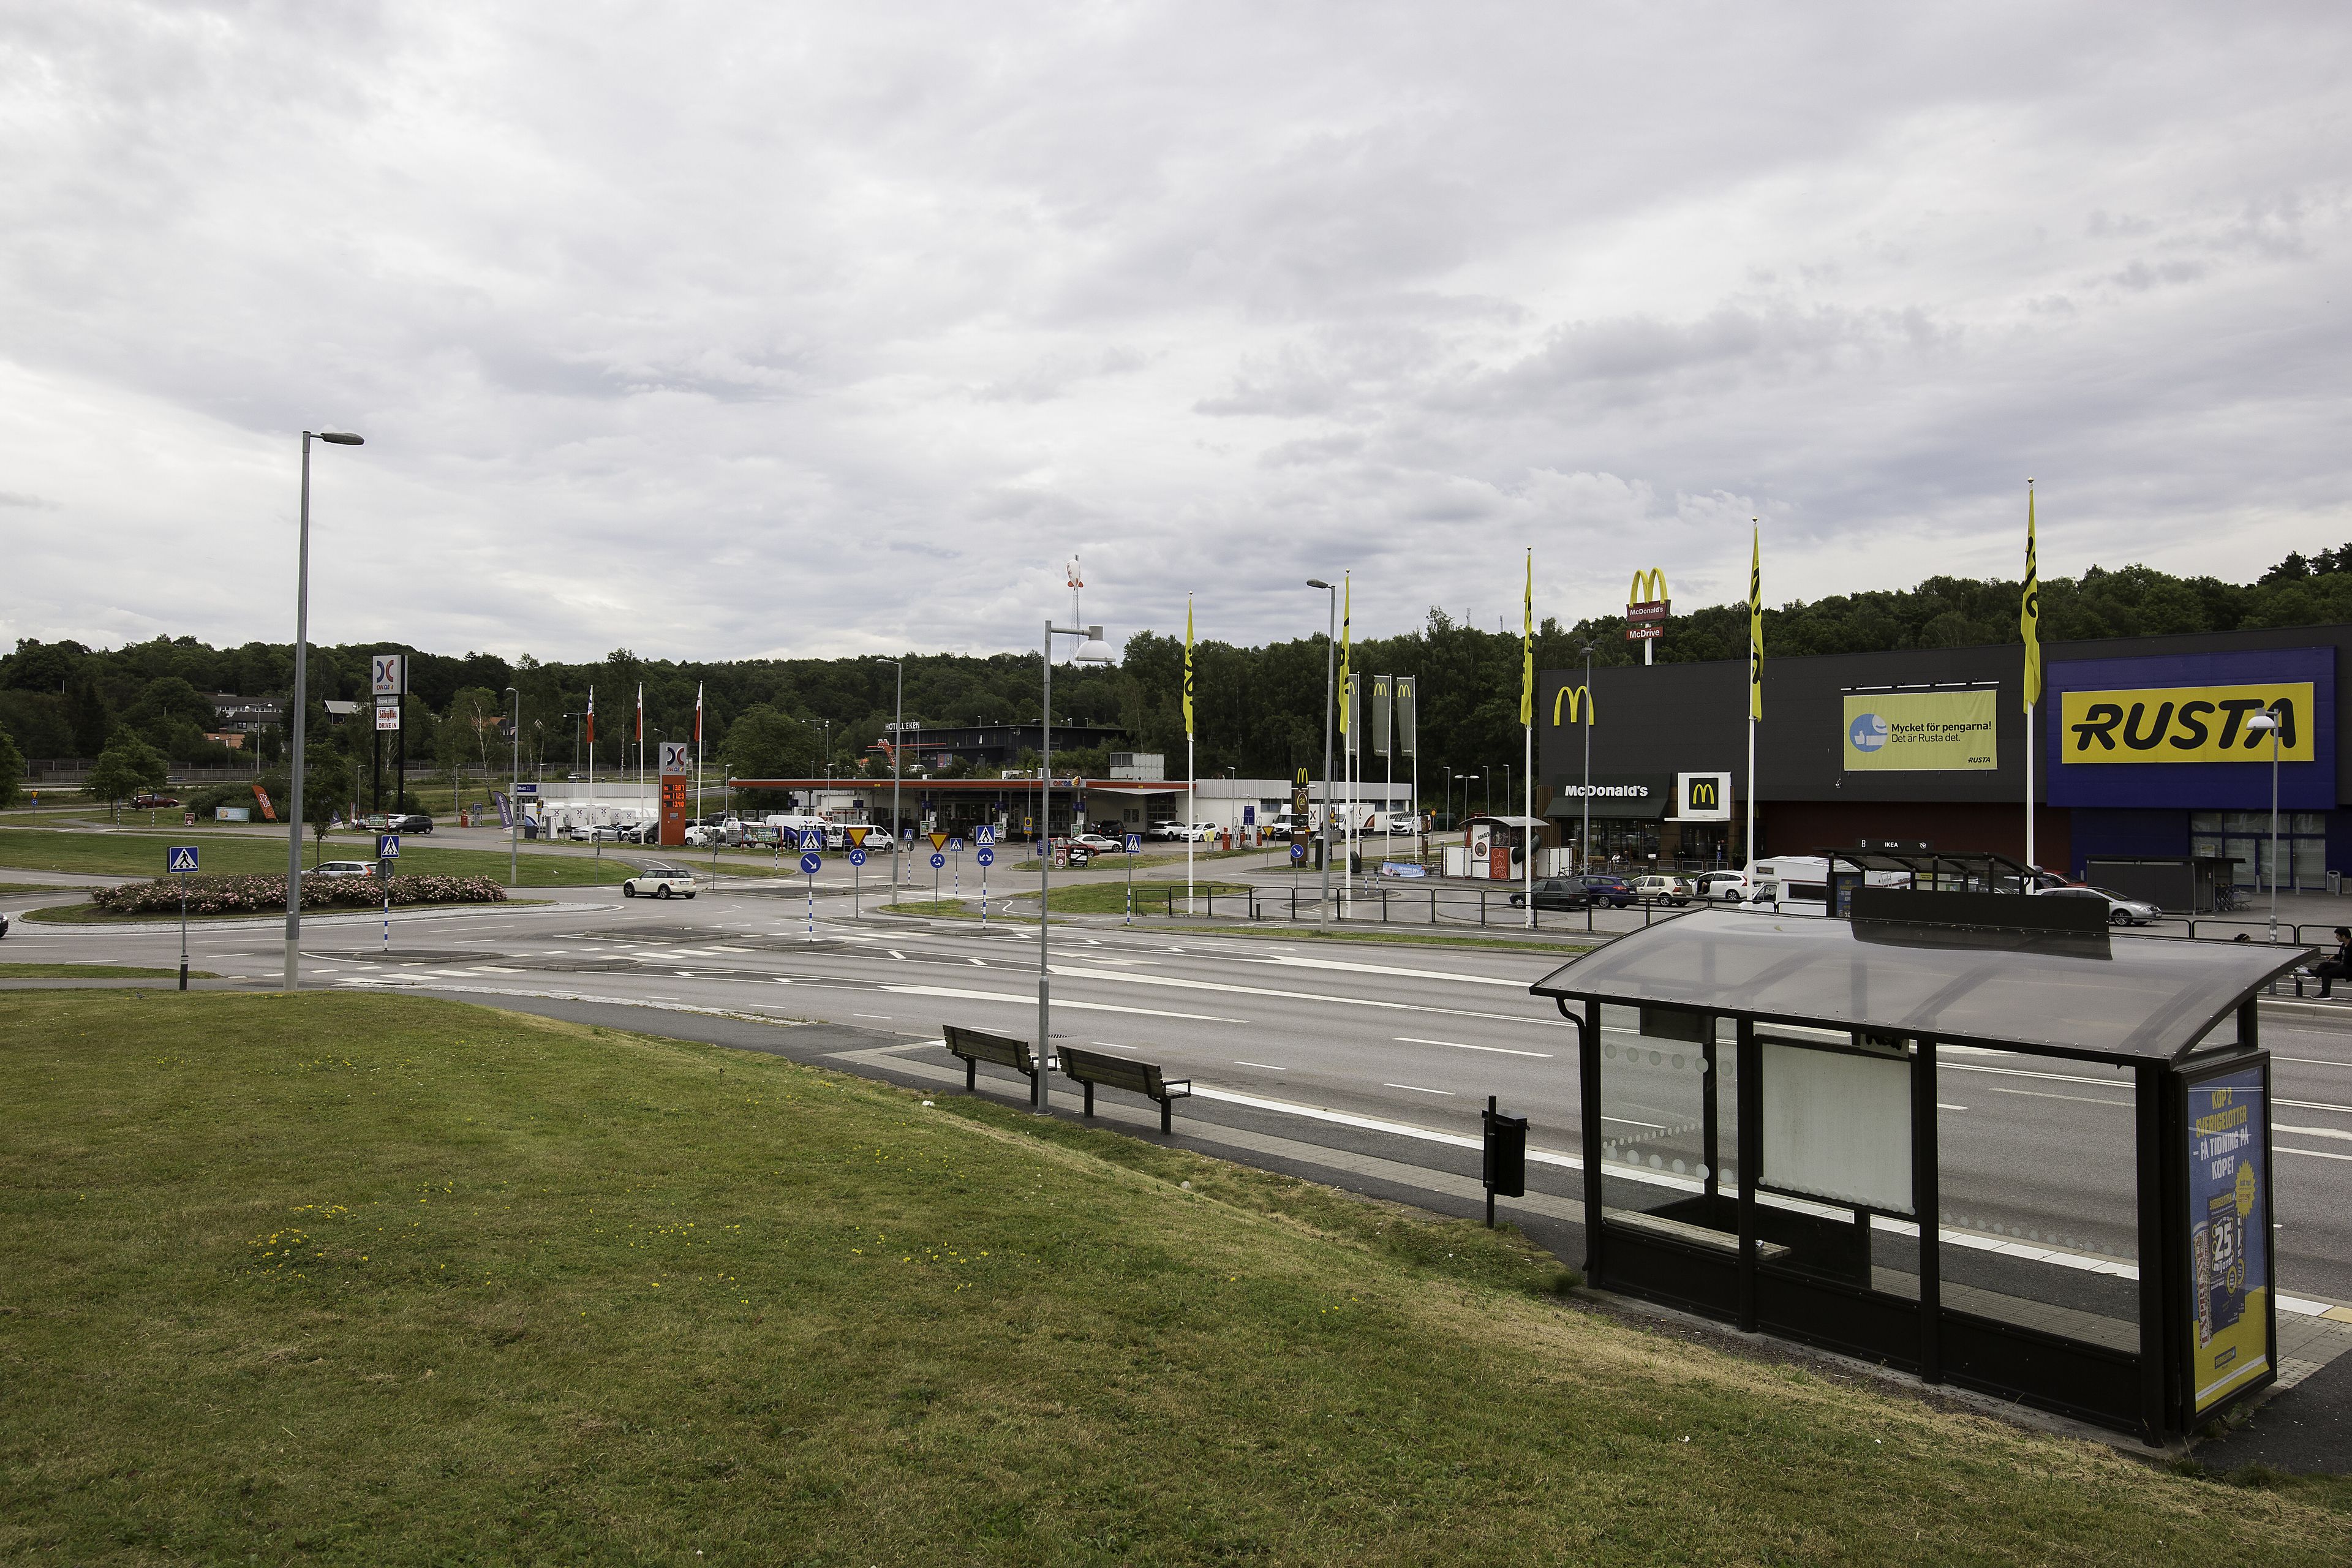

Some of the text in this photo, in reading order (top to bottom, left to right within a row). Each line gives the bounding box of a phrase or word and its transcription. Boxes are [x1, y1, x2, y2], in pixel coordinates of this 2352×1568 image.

[1630, 606, 1664, 616] McDonald's
[1629, 629, 1660, 639] McDrive
[379, 709, 396, 720] Sibylla
[1891, 721, 1991, 734] Mycket för pengarna!
[2071, 698, 2297, 751] RUSTA
[1918, 733, 1943, 742] Rusta
[1945, 733, 1961, 742] det.
[1564, 785, 1648, 797] McDonald's
[2212, 1087, 2232, 1109] KÖP 2
[2210, 1131, 2238, 1156] TIDNING
[2240, 1125, 2249, 1144] PÅ
[2211, 1155, 2234, 1180] KÖPET
[2215, 1223, 2232, 1261] 25
[2214, 1255, 2233, 1273] miljoner
